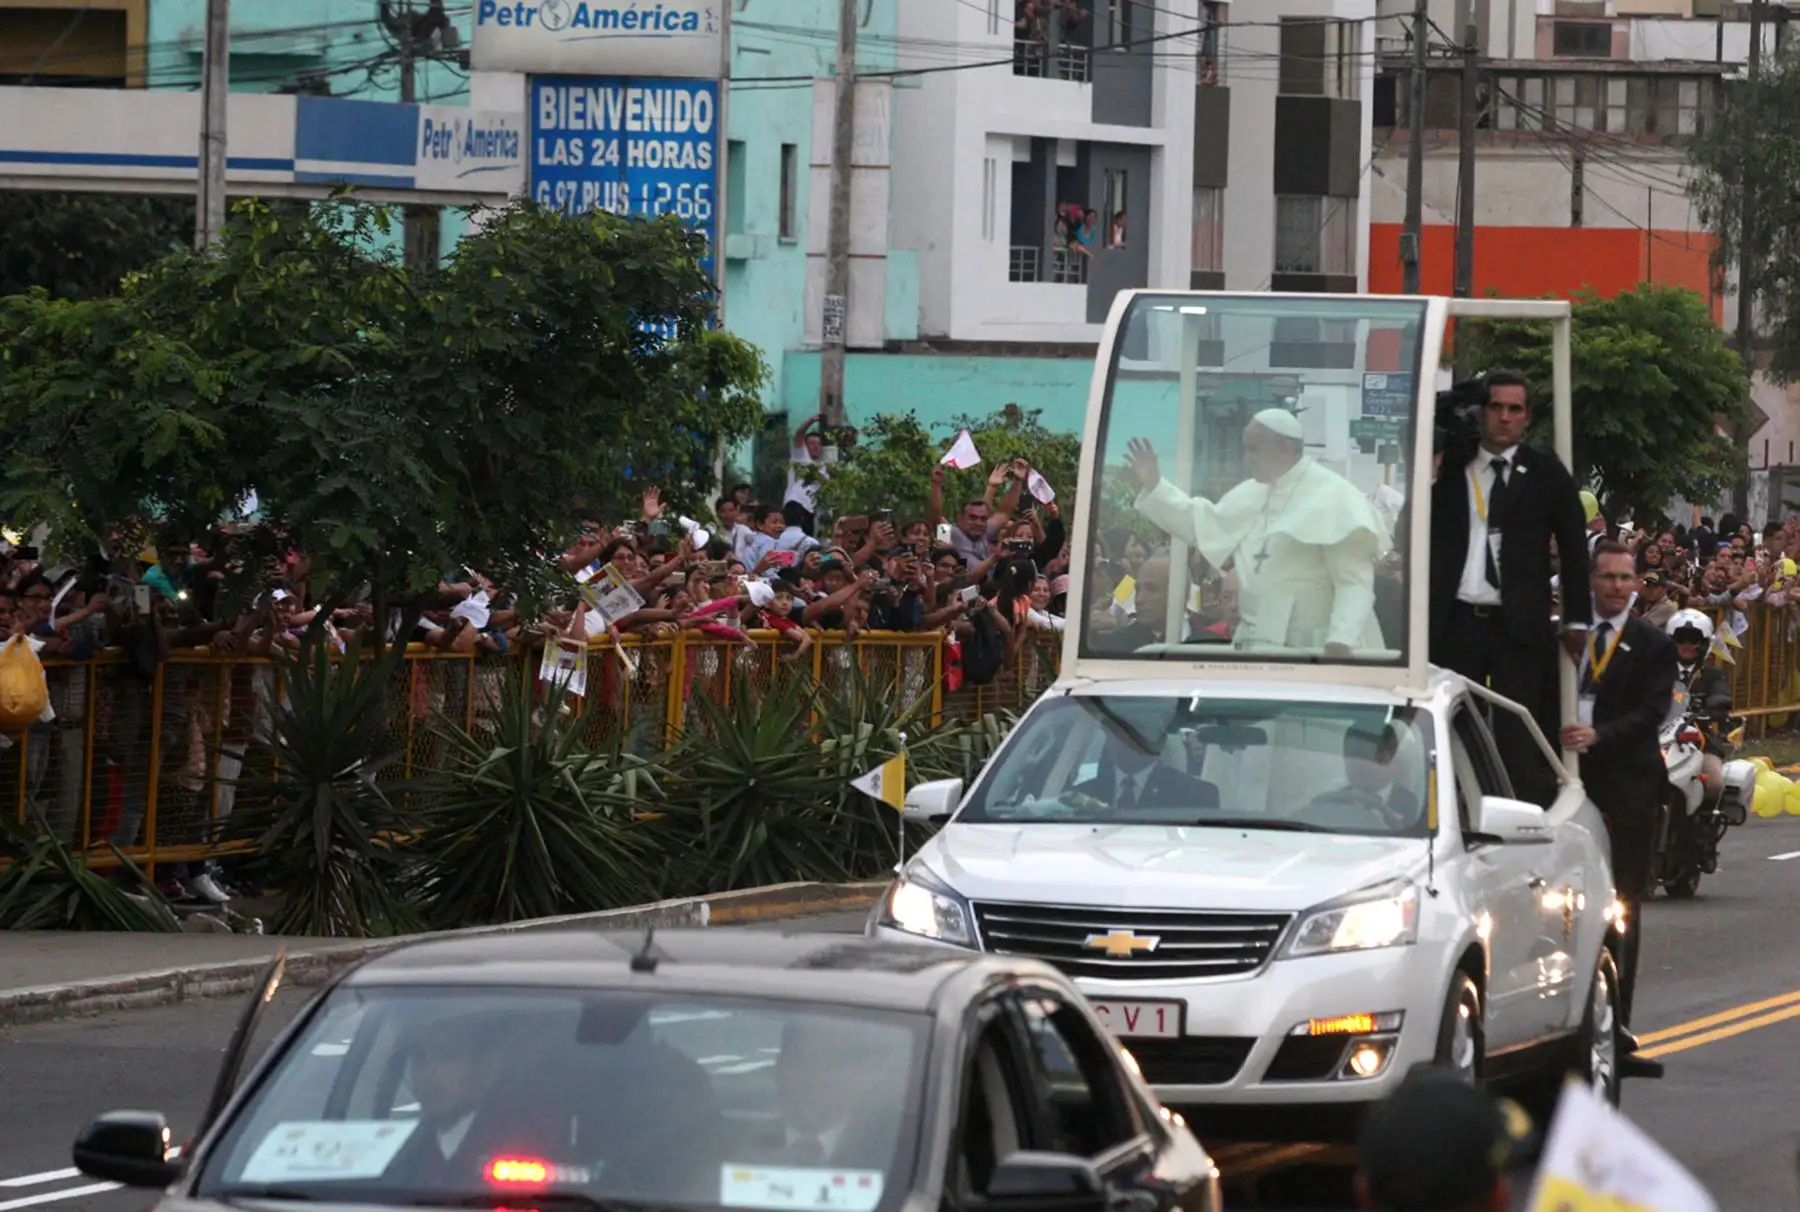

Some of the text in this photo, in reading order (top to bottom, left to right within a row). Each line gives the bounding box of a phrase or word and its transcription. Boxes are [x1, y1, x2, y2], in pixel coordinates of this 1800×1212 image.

[571, 2, 700, 31] América
[539, 86, 713, 133] BIENVENIDO
[463, 118, 518, 159] América
[538, 137, 713, 170] LAS 24 HORAS
[641, 182, 712, 220] 12.66
